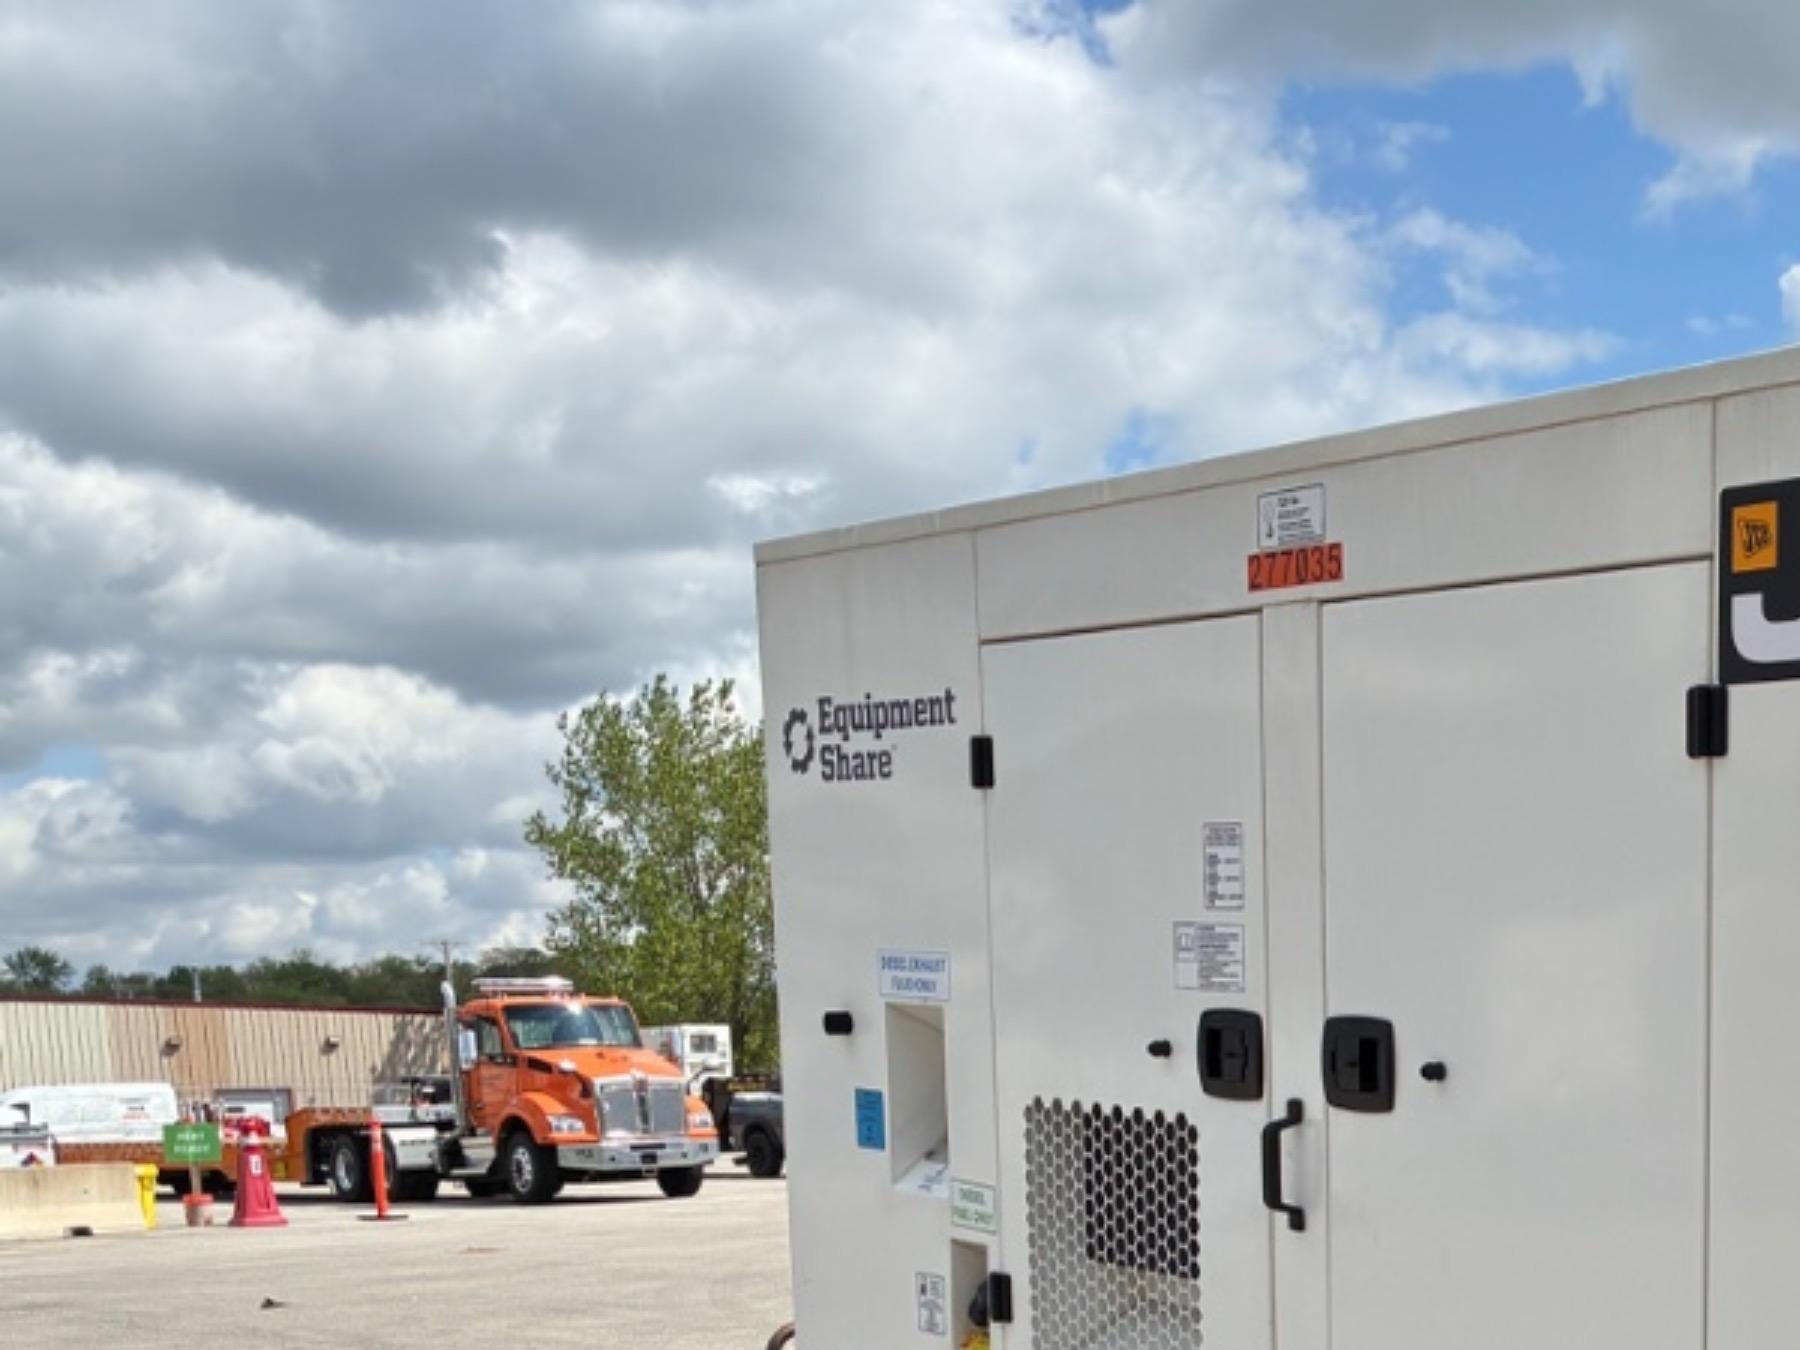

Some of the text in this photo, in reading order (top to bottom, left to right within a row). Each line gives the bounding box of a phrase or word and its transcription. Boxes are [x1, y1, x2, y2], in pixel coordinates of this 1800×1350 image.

[1248, 542, 1342, 592] 277035
[818, 687, 956, 741] Equipment
[820, 743, 893, 781] Share
